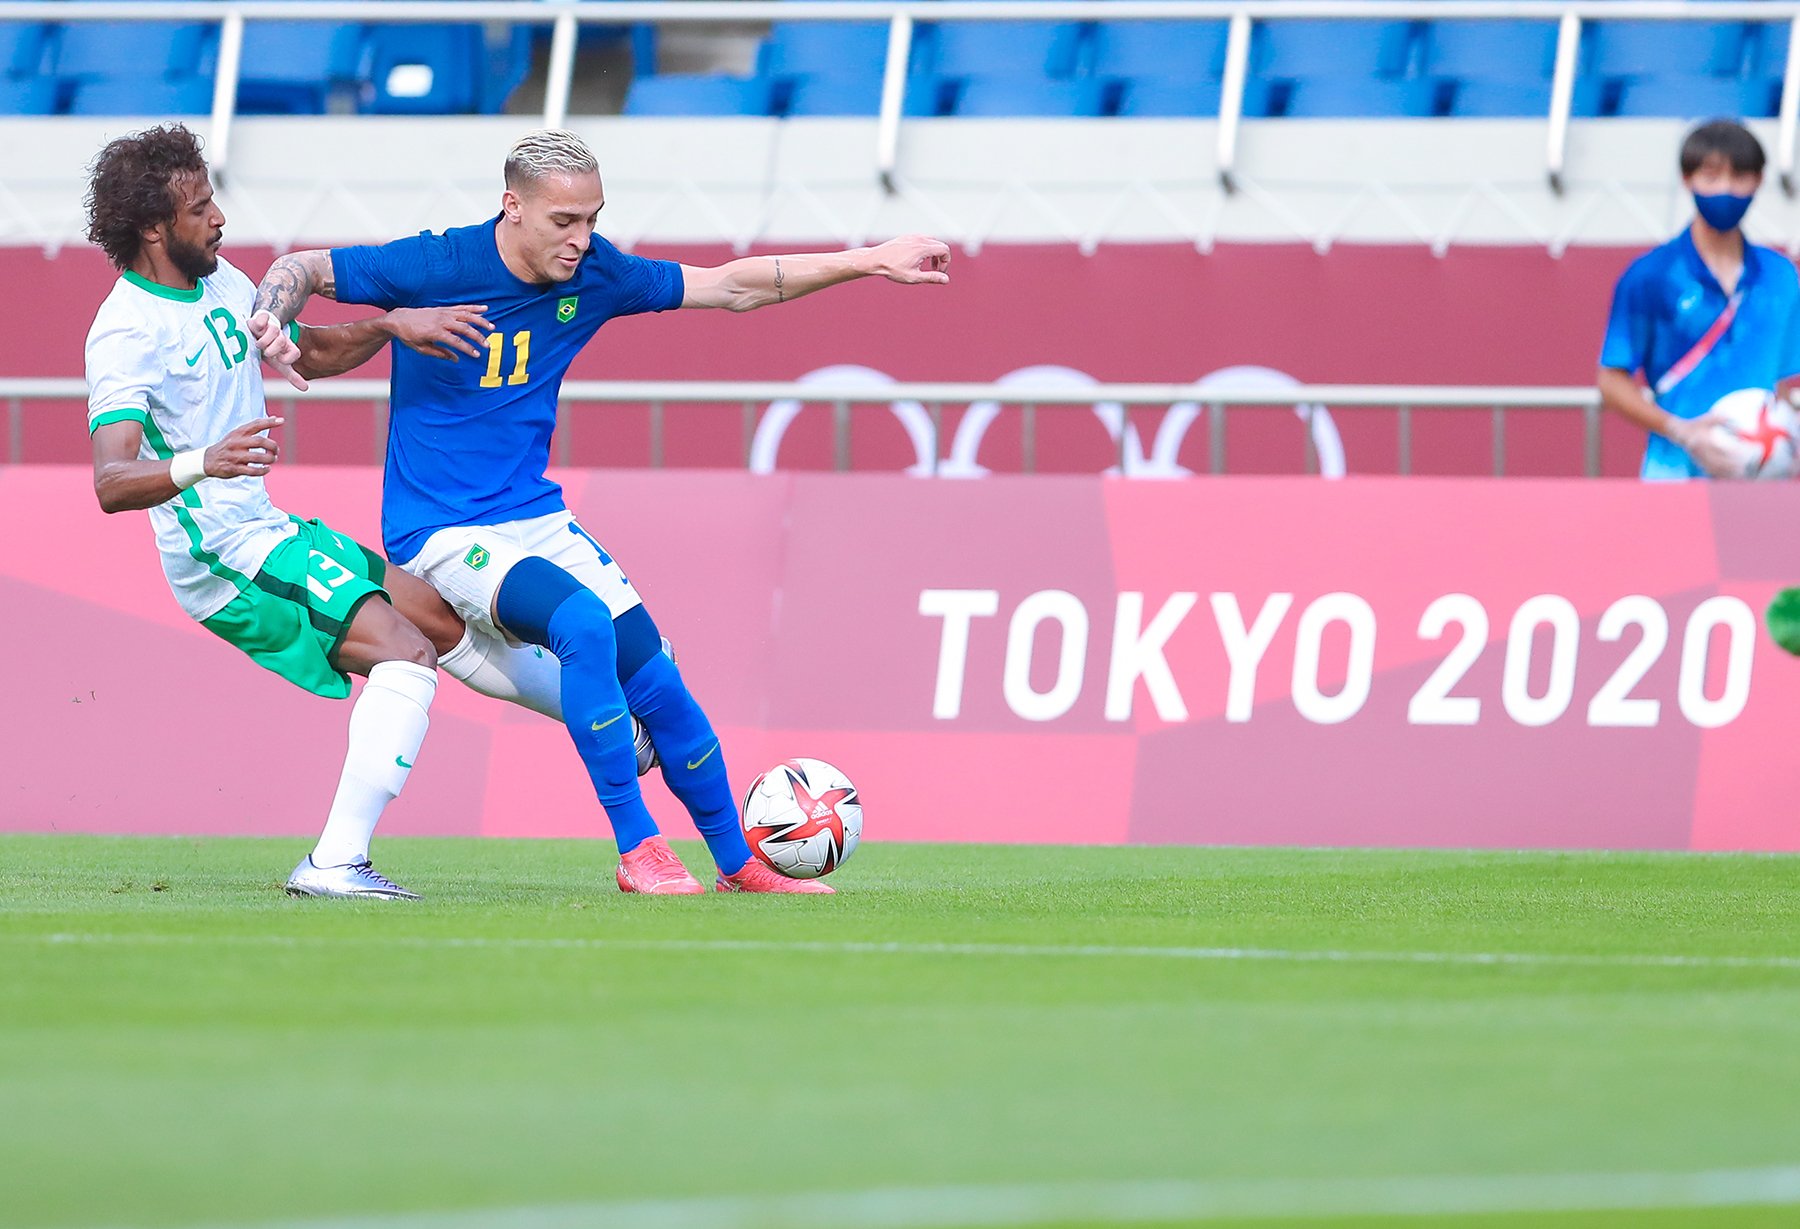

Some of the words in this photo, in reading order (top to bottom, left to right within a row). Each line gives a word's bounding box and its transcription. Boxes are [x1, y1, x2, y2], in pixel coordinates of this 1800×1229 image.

[203, 307, 248, 370] 13
[480, 330, 531, 388] 11
[306, 549, 356, 603] 13
[918, 589, 1376, 724] TOKYO
[1408, 594, 1756, 727] 2020
